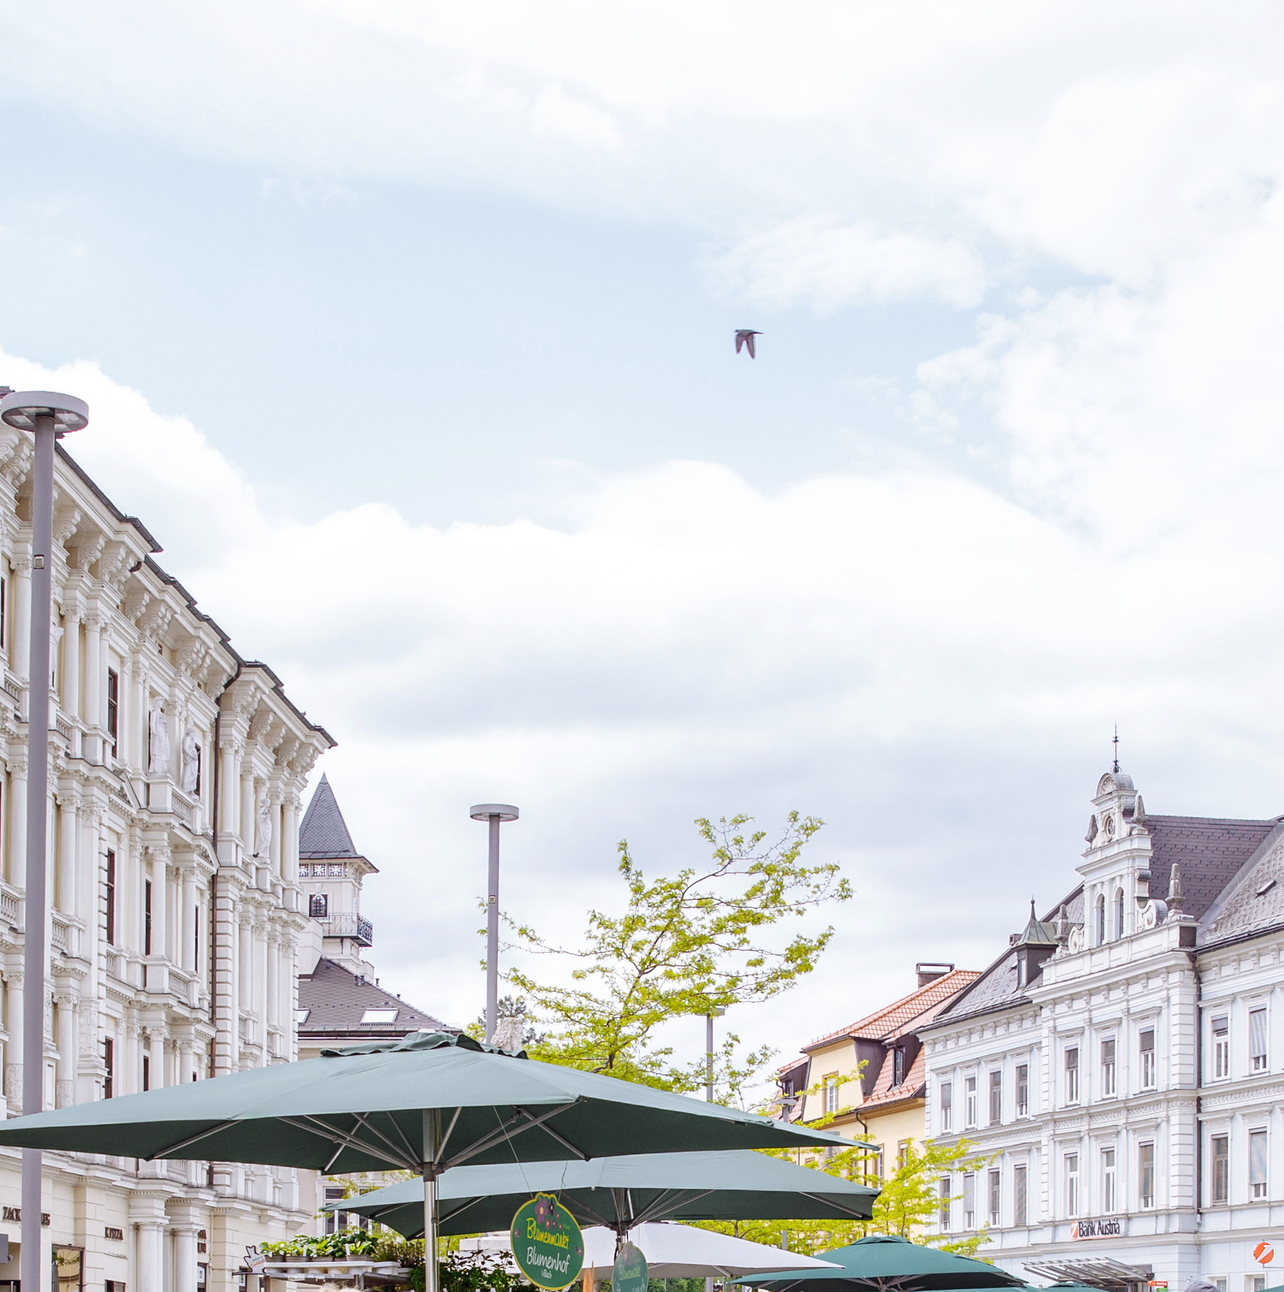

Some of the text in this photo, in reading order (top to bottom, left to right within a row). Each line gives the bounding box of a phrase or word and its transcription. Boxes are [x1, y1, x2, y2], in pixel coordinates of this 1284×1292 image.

[1078, 1218, 1121, 1238] Bank Austria
[526, 1246, 571, 1274] Blumenhof
